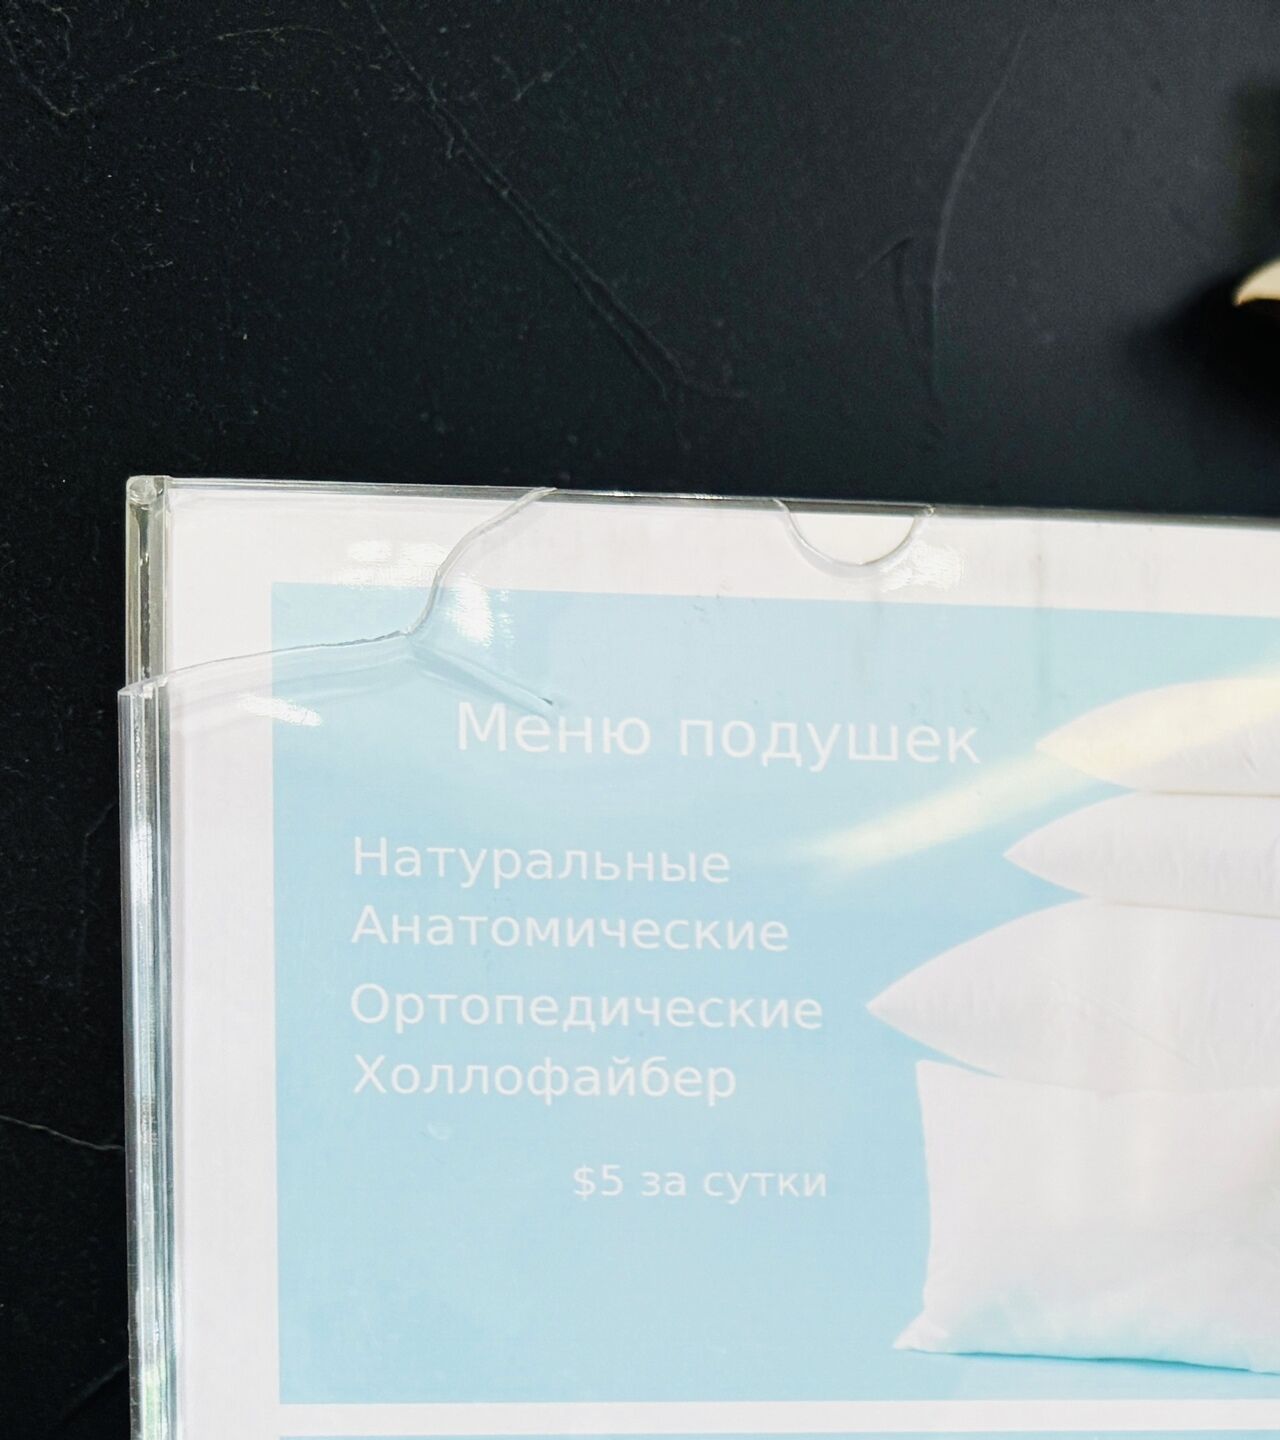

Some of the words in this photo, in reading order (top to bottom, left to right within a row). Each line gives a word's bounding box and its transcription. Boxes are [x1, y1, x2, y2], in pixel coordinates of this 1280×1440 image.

[459, 702, 651, 755] Меню
[680, 717, 980, 769] подушек
[355, 837, 729, 888] Натуральные
[352, 905, 788, 952] Анатомические
[351, 983, 822, 1034] Ортопедические
[353, 1055, 736, 1107] Холлофайбер
[573, 1164, 623, 1200] $5
[641, 1172, 686, 1196] за
[704, 1172, 826, 1204] сутки
